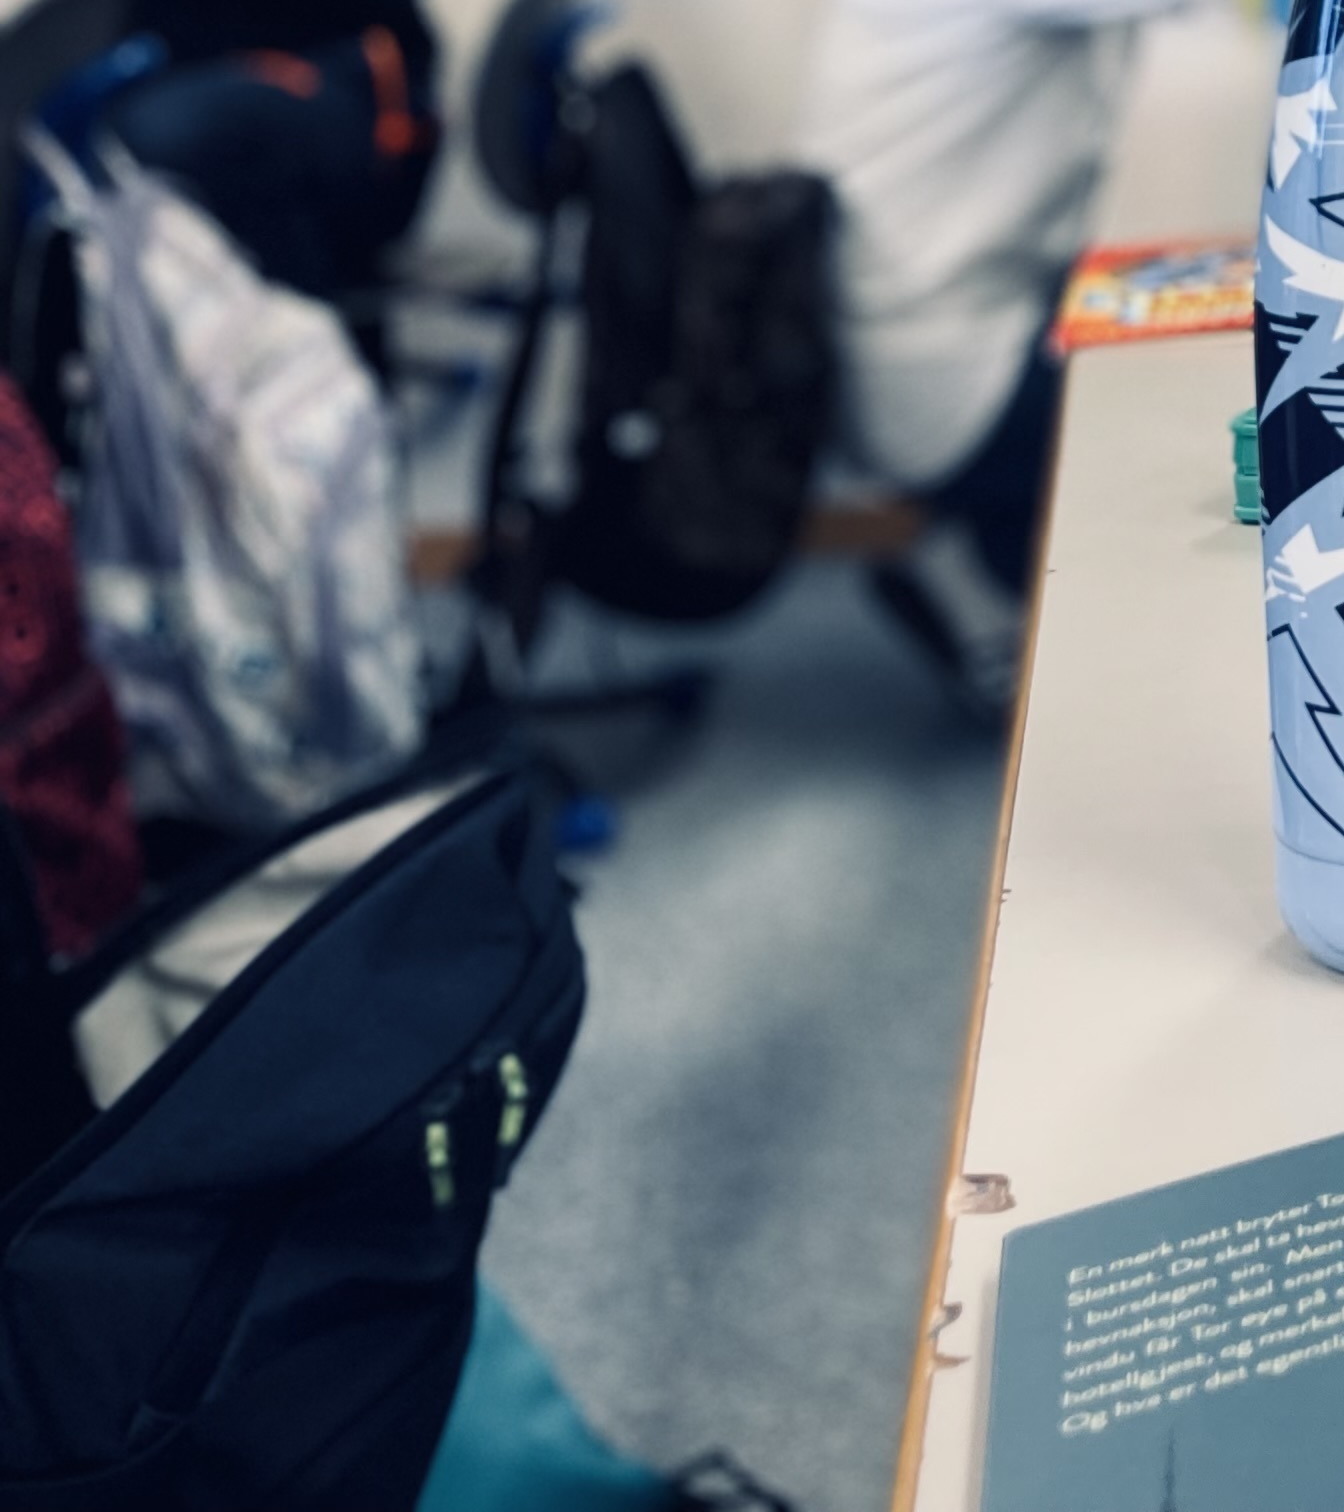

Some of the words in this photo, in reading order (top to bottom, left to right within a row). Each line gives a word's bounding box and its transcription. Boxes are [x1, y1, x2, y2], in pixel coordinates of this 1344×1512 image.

[1068, 1271, 1162, 1306] Slottet.
[1171, 1257, 1208, 1275] De
[1216, 1237, 1259, 1262] skal
[1267, 1232, 1290, 1247] ta
[1069, 1265, 1102, 1285] En
[1109, 1241, 1173, 1271] mørk
[1181, 1226, 1230, 1250] natt
[1237, 1203, 1311, 1234] bryter
[1088, 1277, 1217, 1325] bursdagen
[1286, 1239, 1343, 1264] Men
[1193, 1322, 1231, 1340] Tor
[1242, 1304, 1288, 1326] øye
[1298, 1288, 1326, 1313] på
[1227, 1279, 1273, 1305] skal
[1221, 1339, 1253, 1358] og
[1062, 1411, 1107, 1433] Og
[1115, 1394, 1161, 1416] hva
[1169, 1383, 1197, 1400] er
[1206, 1366, 1247, 1389] det
